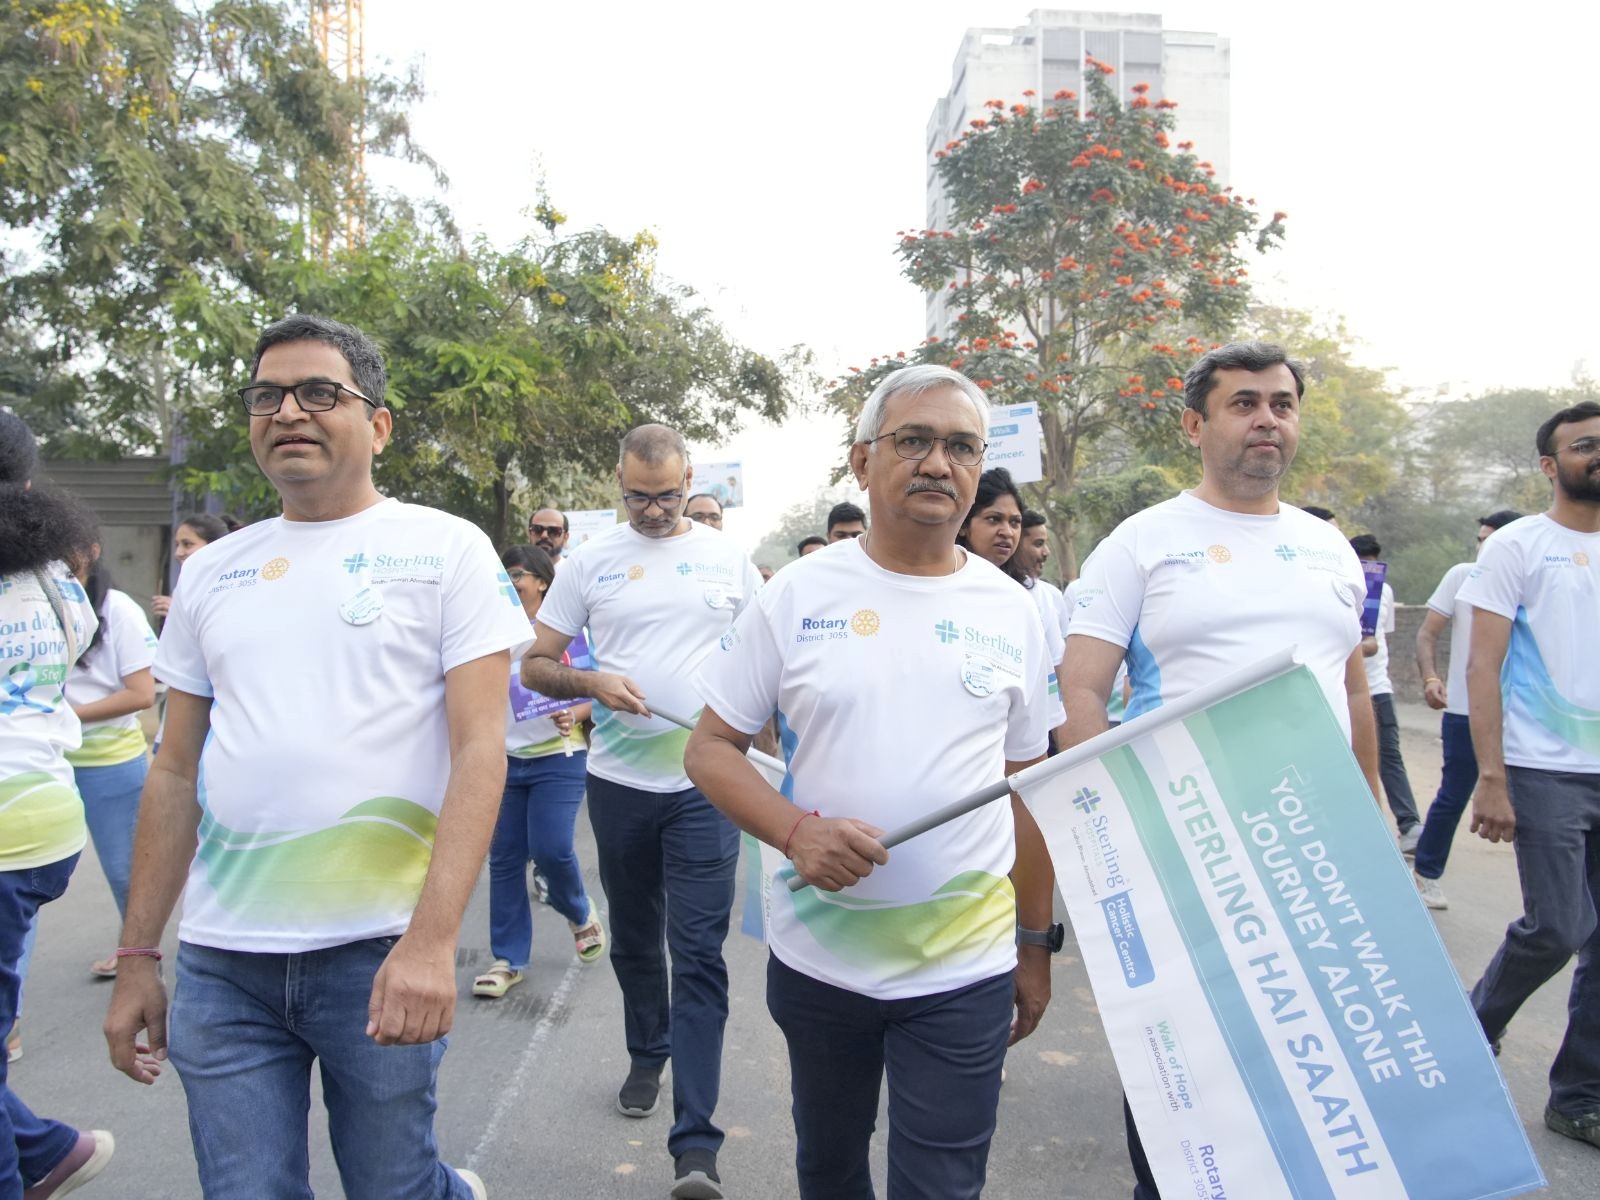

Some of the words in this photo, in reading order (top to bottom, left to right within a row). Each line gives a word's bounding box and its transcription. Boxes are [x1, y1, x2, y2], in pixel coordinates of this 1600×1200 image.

[373, 554, 444, 571] Sterling
[598, 573, 625, 583] Rotary
[796, 633, 824, 643] District
[828, 631, 848, 640] 3055
[802, 618, 848, 630] Rotary
[964, 626, 1024, 664] Sterling
[1092, 815, 1125, 889] Sterling
[1116, 897, 1134, 939] Holistic
[1270, 777, 1315, 835] YOU
[1300, 840, 1365, 925] DON'T
[1350, 930, 1412, 1019] WALK
[1397, 1020, 1446, 1089] THIS
[1106, 902, 1123, 939] Cancer
[1119, 940, 1137, 979] Centre
[1241, 811, 1339, 950] JOURNEY
[1318, 965, 1402, 1084] ALONE
[1168, 774, 1267, 945] STERLING
[1248, 952, 1308, 1025] HAI
[1287, 1033, 1379, 1177] SAATH
[1157, 1020, 1176, 1053] Walk
[1145, 1026, 1153, 1036] in
[1149, 1037, 1171, 1089] association
[1167, 1091, 1179, 1112] with
[1169, 1056, 1183, 1071] of
[1174, 1073, 1193, 1110] Hope
[1180, 1139, 1199, 1175] District
[1198, 1144, 1227, 1200] Rotary
